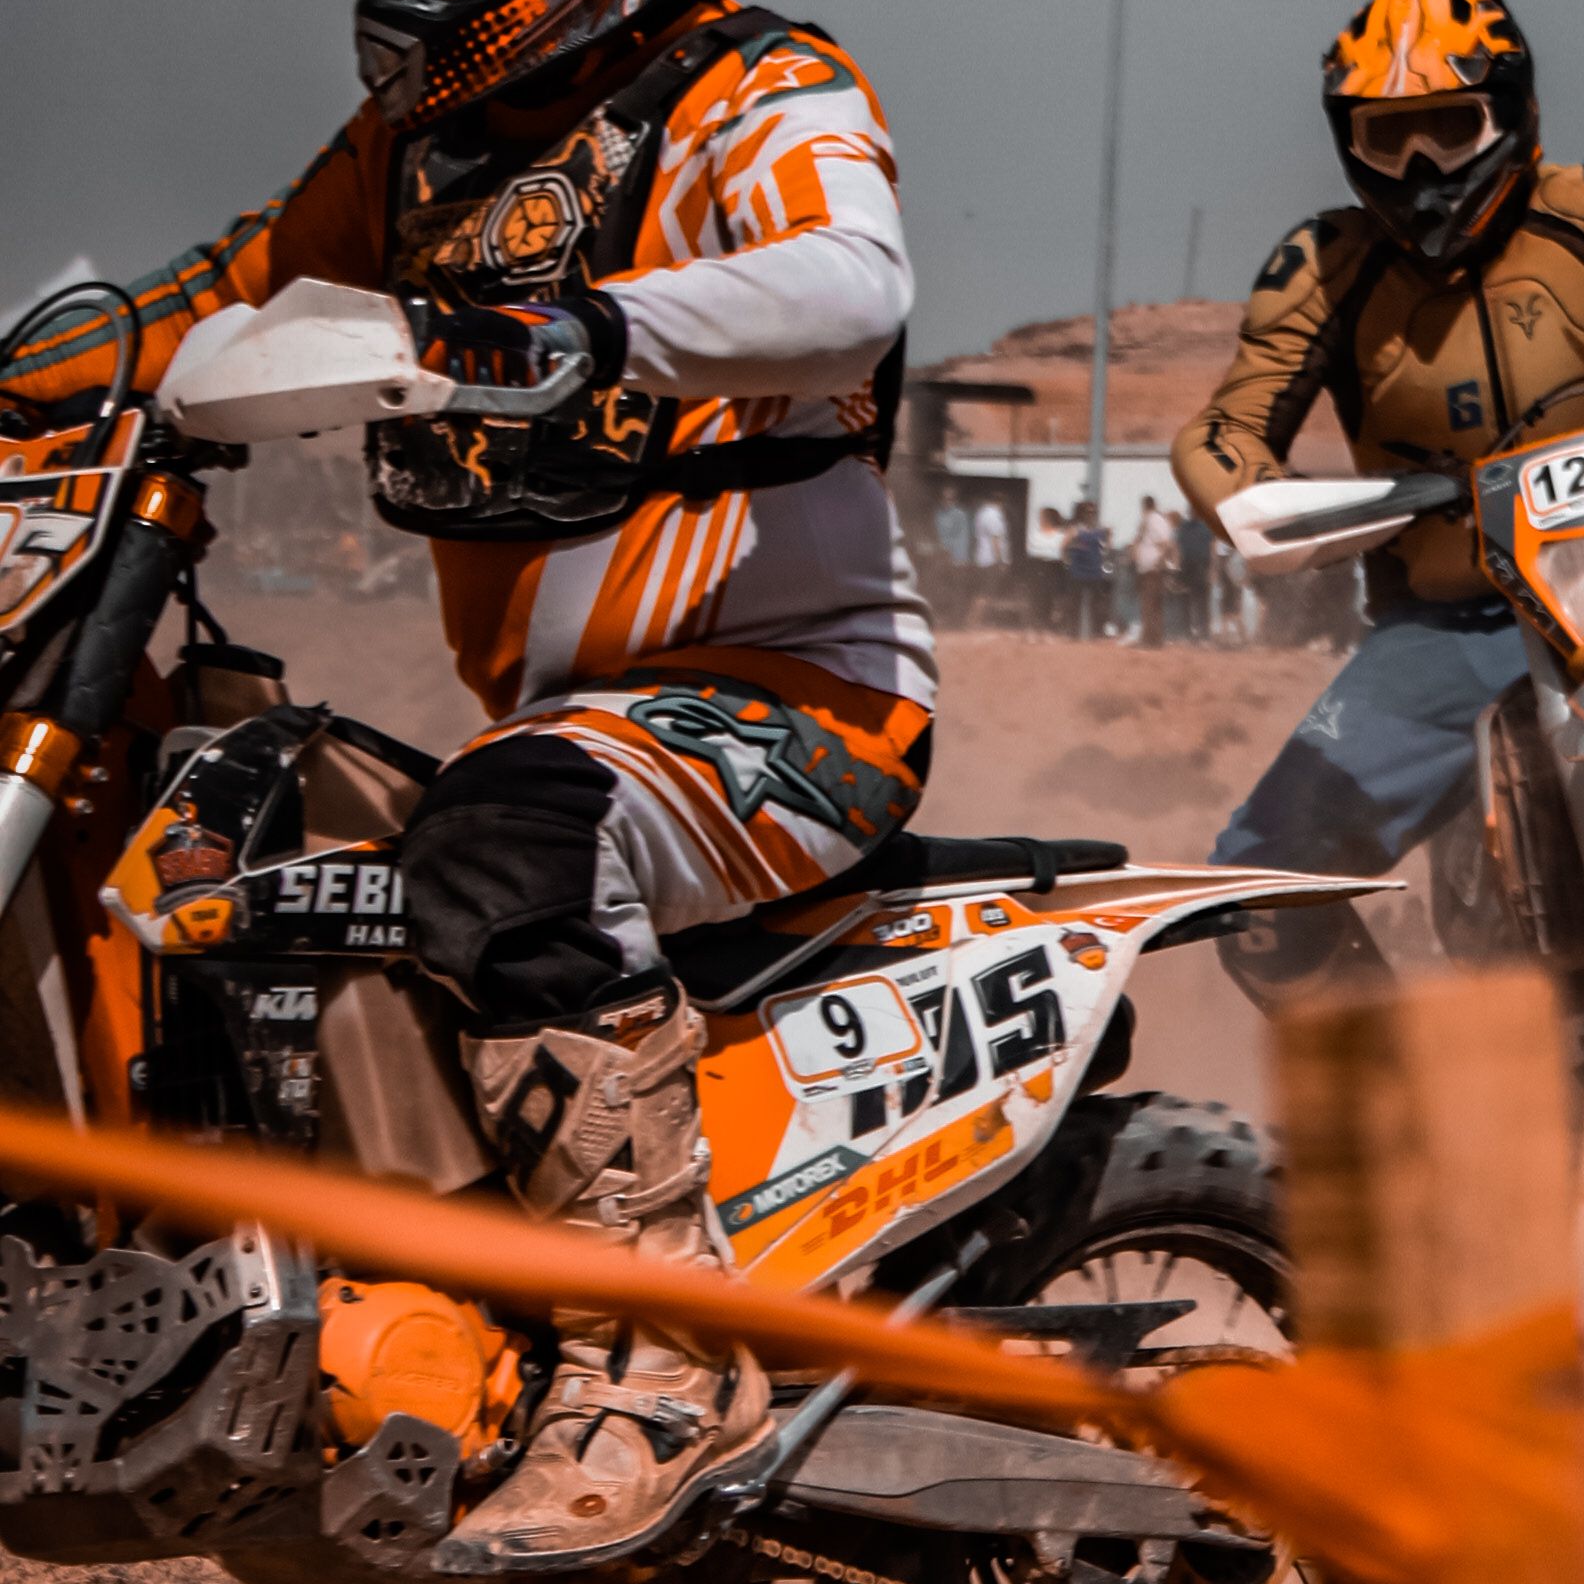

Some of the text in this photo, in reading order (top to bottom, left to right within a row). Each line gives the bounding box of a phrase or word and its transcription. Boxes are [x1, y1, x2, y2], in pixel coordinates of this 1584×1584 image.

[820, 993, 866, 1059] 9
[752, 1152, 848, 1215] MOTOREX
[822, 1139, 960, 1240] DHL
